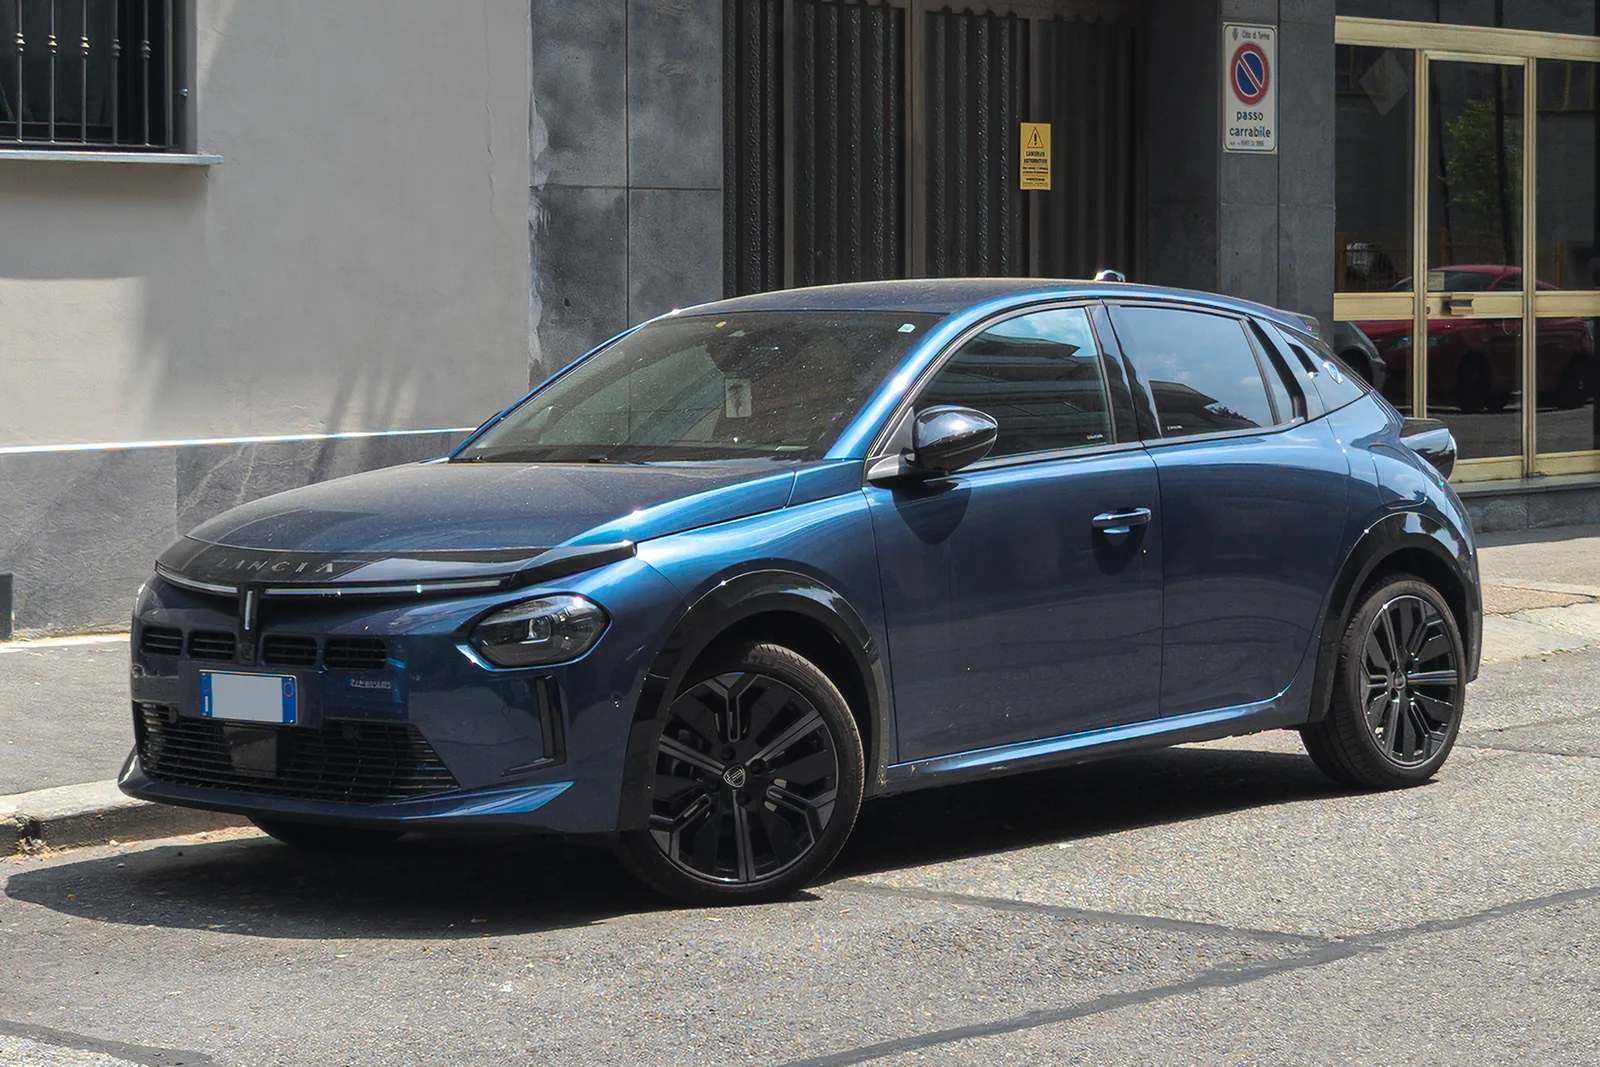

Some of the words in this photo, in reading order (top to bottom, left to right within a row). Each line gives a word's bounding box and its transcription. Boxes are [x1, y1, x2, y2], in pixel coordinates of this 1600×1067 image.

[1236, 111, 1264, 122] passo
[1229, 126, 1271, 138] carrabile
[215, 558, 334, 573] LANCIA
